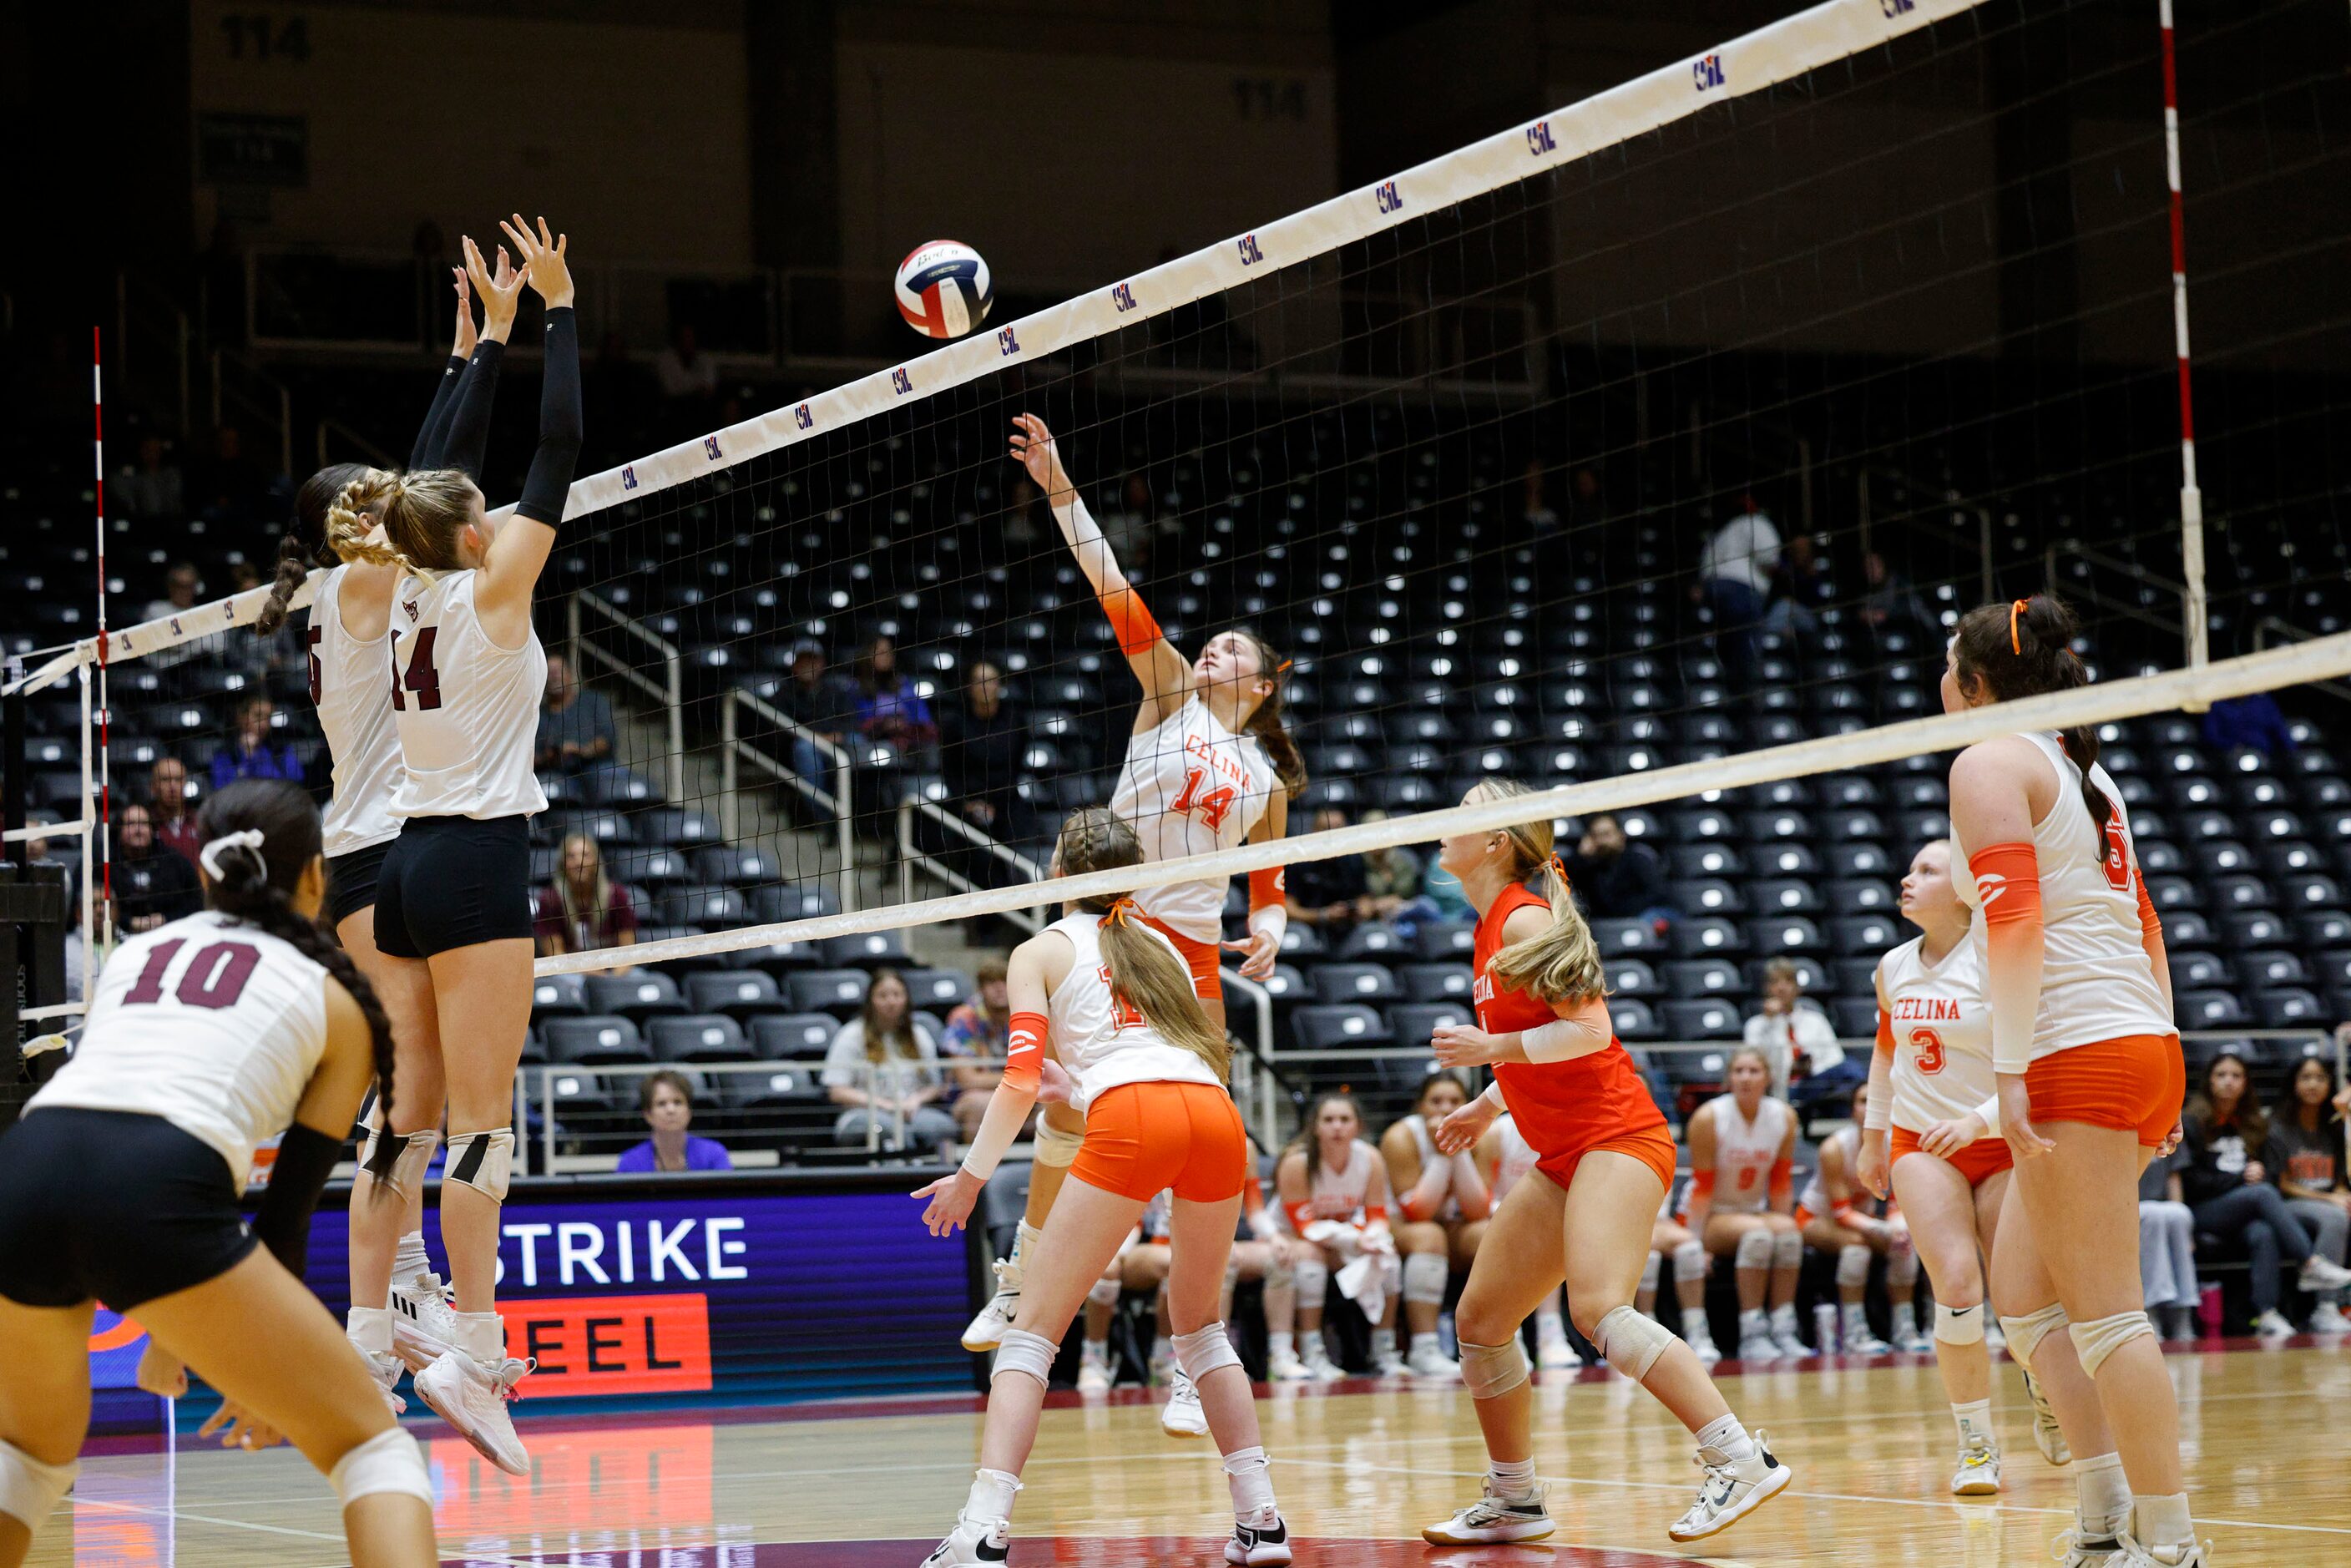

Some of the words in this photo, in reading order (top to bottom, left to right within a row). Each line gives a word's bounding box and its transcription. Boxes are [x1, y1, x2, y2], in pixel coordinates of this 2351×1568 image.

[220, 14, 312, 62] 114
[391, 626, 442, 711] 14
[1186, 735, 1251, 792] CELINA
[1170, 766, 1240, 834] 14
[121, 938, 262, 1009] 10
[1894, 999, 1961, 1019] CELINA
[1909, 1027, 1947, 1075] 3
[503, 1316, 682, 1376] EEL
